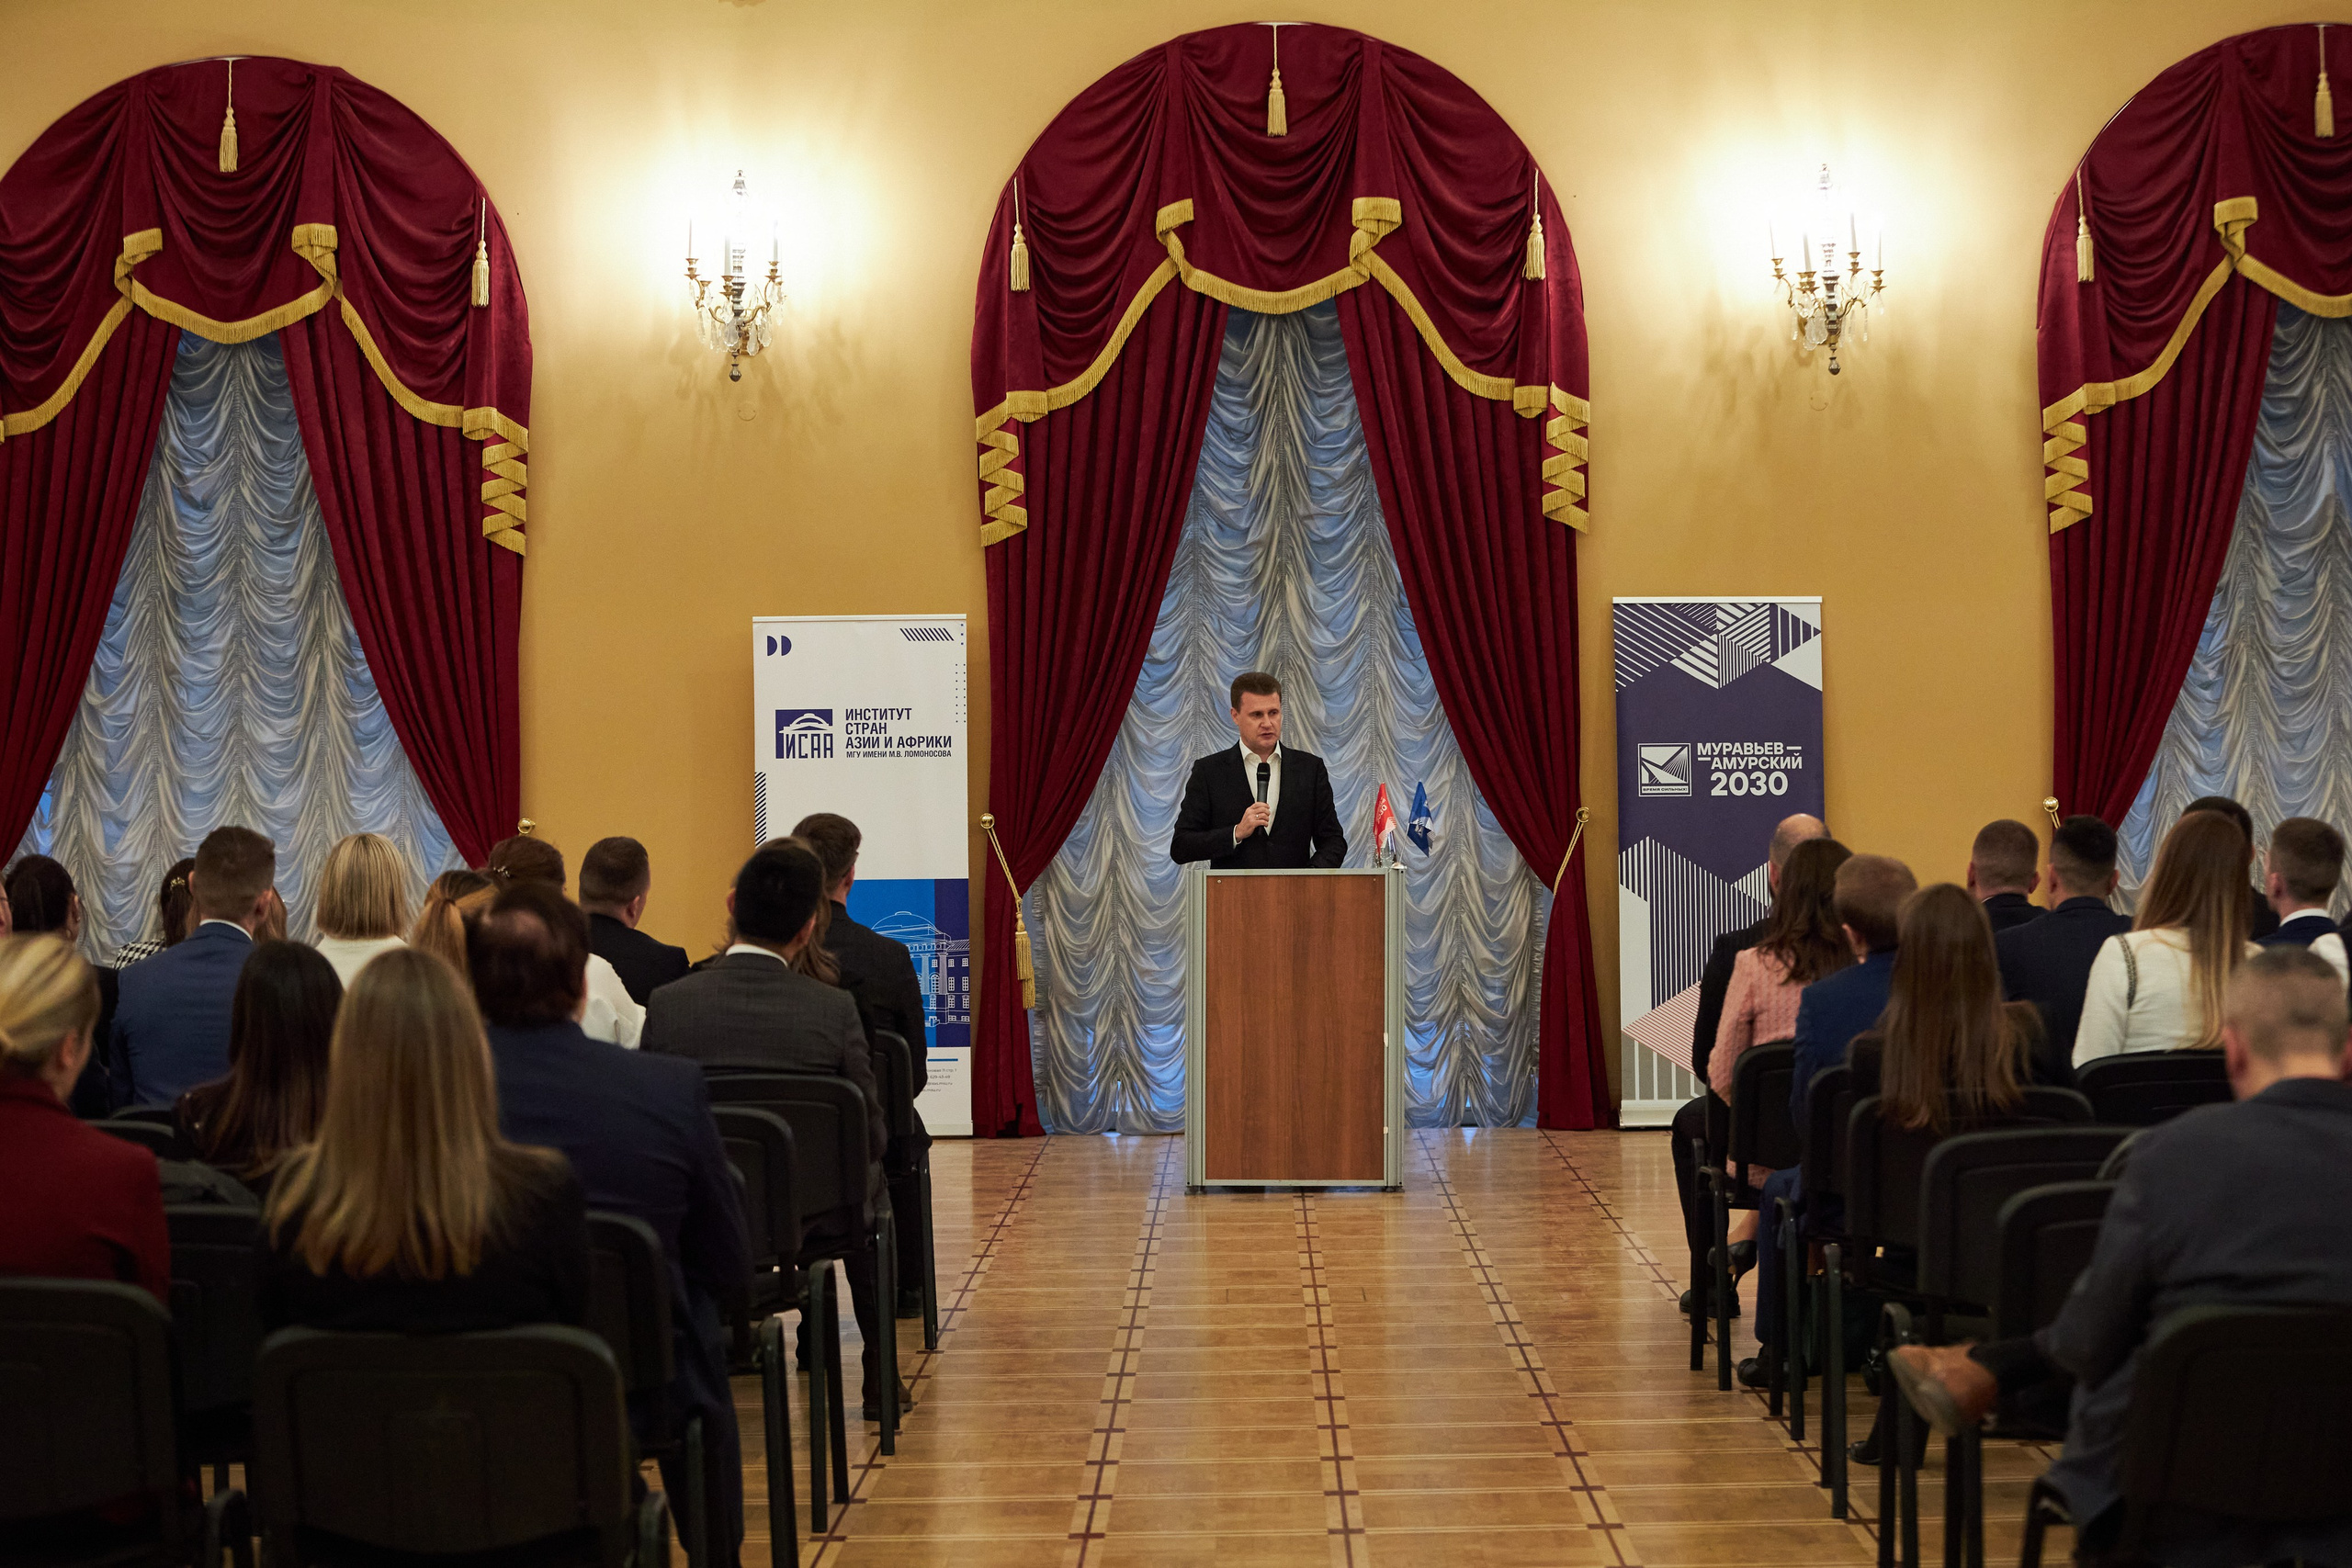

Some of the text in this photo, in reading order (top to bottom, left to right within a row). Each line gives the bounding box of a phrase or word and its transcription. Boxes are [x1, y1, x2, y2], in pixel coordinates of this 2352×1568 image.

[845, 707, 912, 721] ИНСТИТУТ
[845, 722, 888, 735] СТРАН
[845, 735, 952, 750] АЗИИ И АФРИКИ
[888, 750, 903, 758] М.В.
[904, 750, 952, 758] ЛОМОНОСОВА
[1710, 771, 1789, 796] 2030
